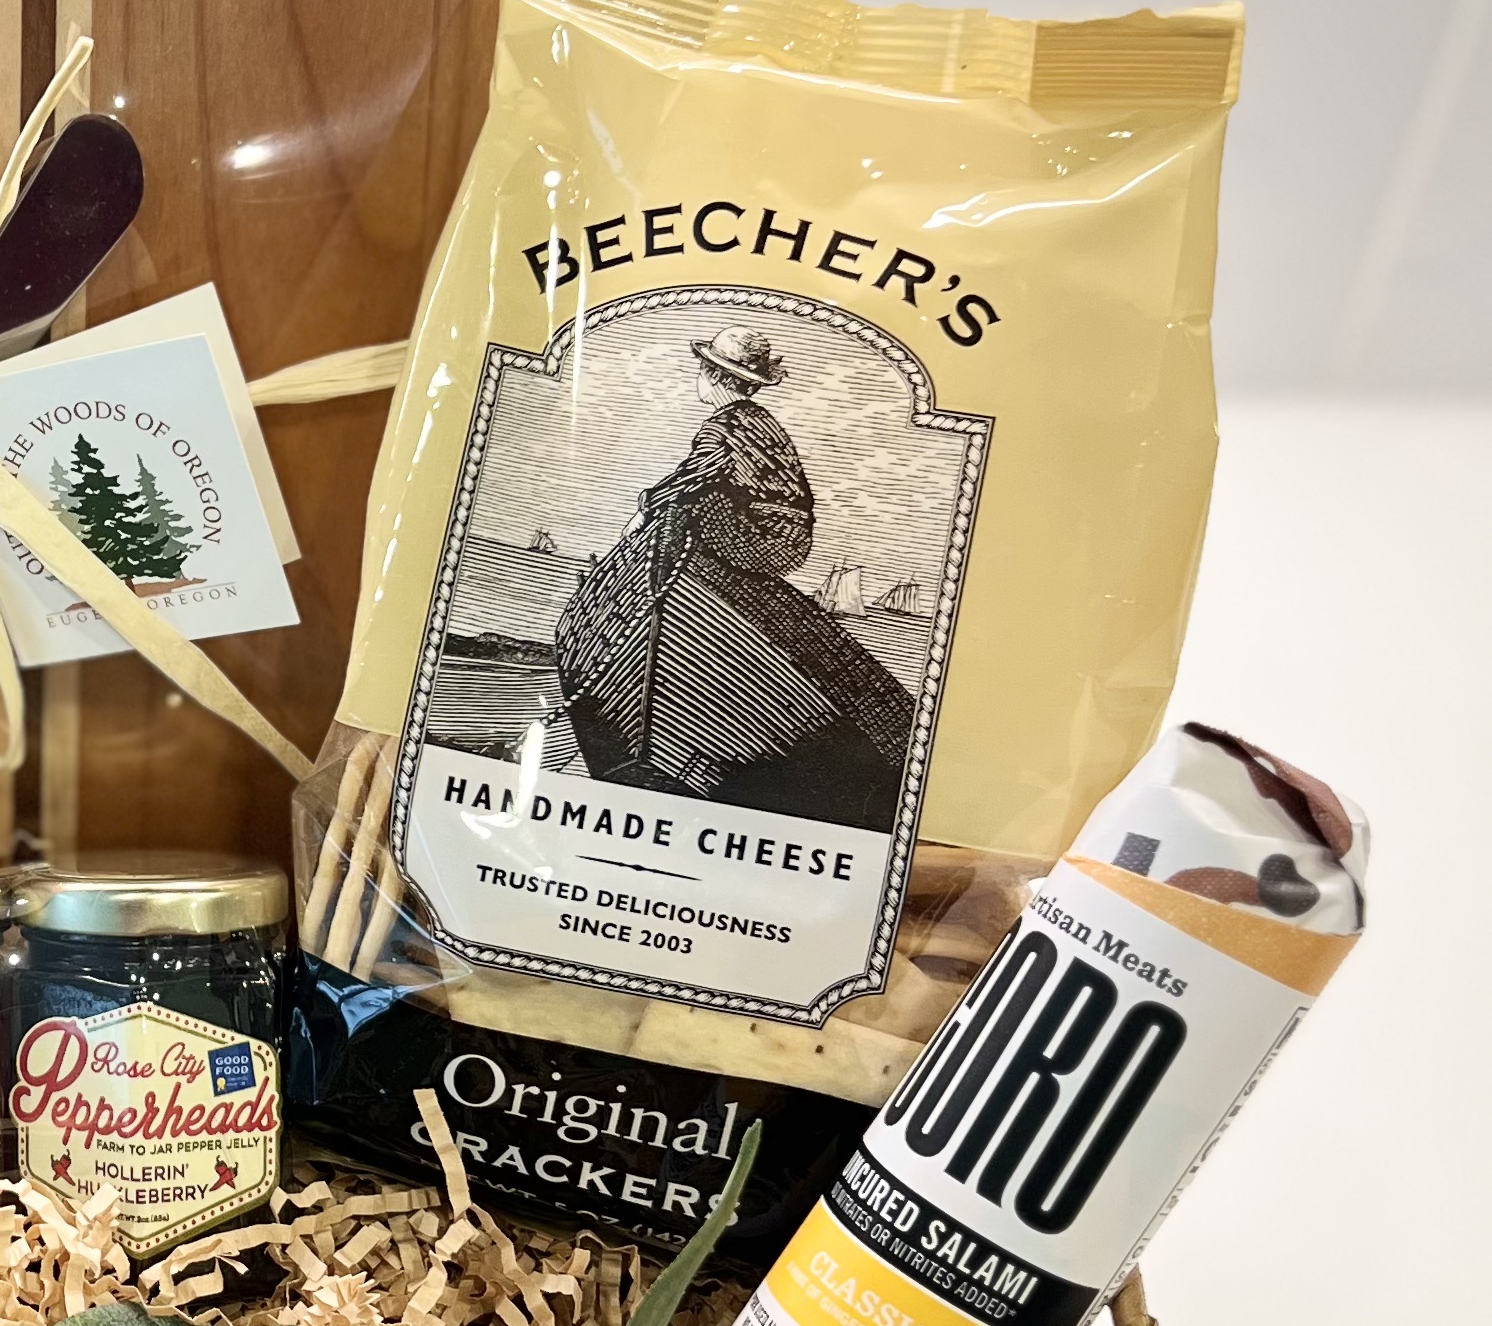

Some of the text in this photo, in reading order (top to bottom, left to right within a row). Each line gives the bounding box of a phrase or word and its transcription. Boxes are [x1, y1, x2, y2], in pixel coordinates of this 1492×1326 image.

[521, 200, 1002, 347] BEECHER'S
[29, 401, 126, 435] WOODS
[135, 412, 171, 438] OF
[172, 439, 222, 545] OREGON
[146, 585, 238, 610] OREGON
[445, 775, 855, 881] HANDMADE CHEESE
[476, 864, 793, 943] TRUSTED DELICIOUSNESS
[559, 913, 694, 954] SINCE 2003
[1093, 929, 1188, 998] Meats
[12, 1020, 277, 1149] Pepperheads
[91, 1041, 206, 1083] Rose City
[215, 1055, 249, 1065] GOOD
[215, 1065, 249, 1075] FOOD
[443, 1054, 739, 1161] Original
[95, 1160, 189, 1182] HOLLERIN'
[97, 1137, 260, 1156] FARM TO JAR PEPPER JELLY
[410, 1121, 741, 1227] CRACKERS
[78, 1179, 209, 1204] HUKLEBERRY
[842, 1150, 1038, 1304] UNCURED SALAMI
[870, 1224, 892, 1247] OR
[889, 1238, 956, 1290] NITRITES
